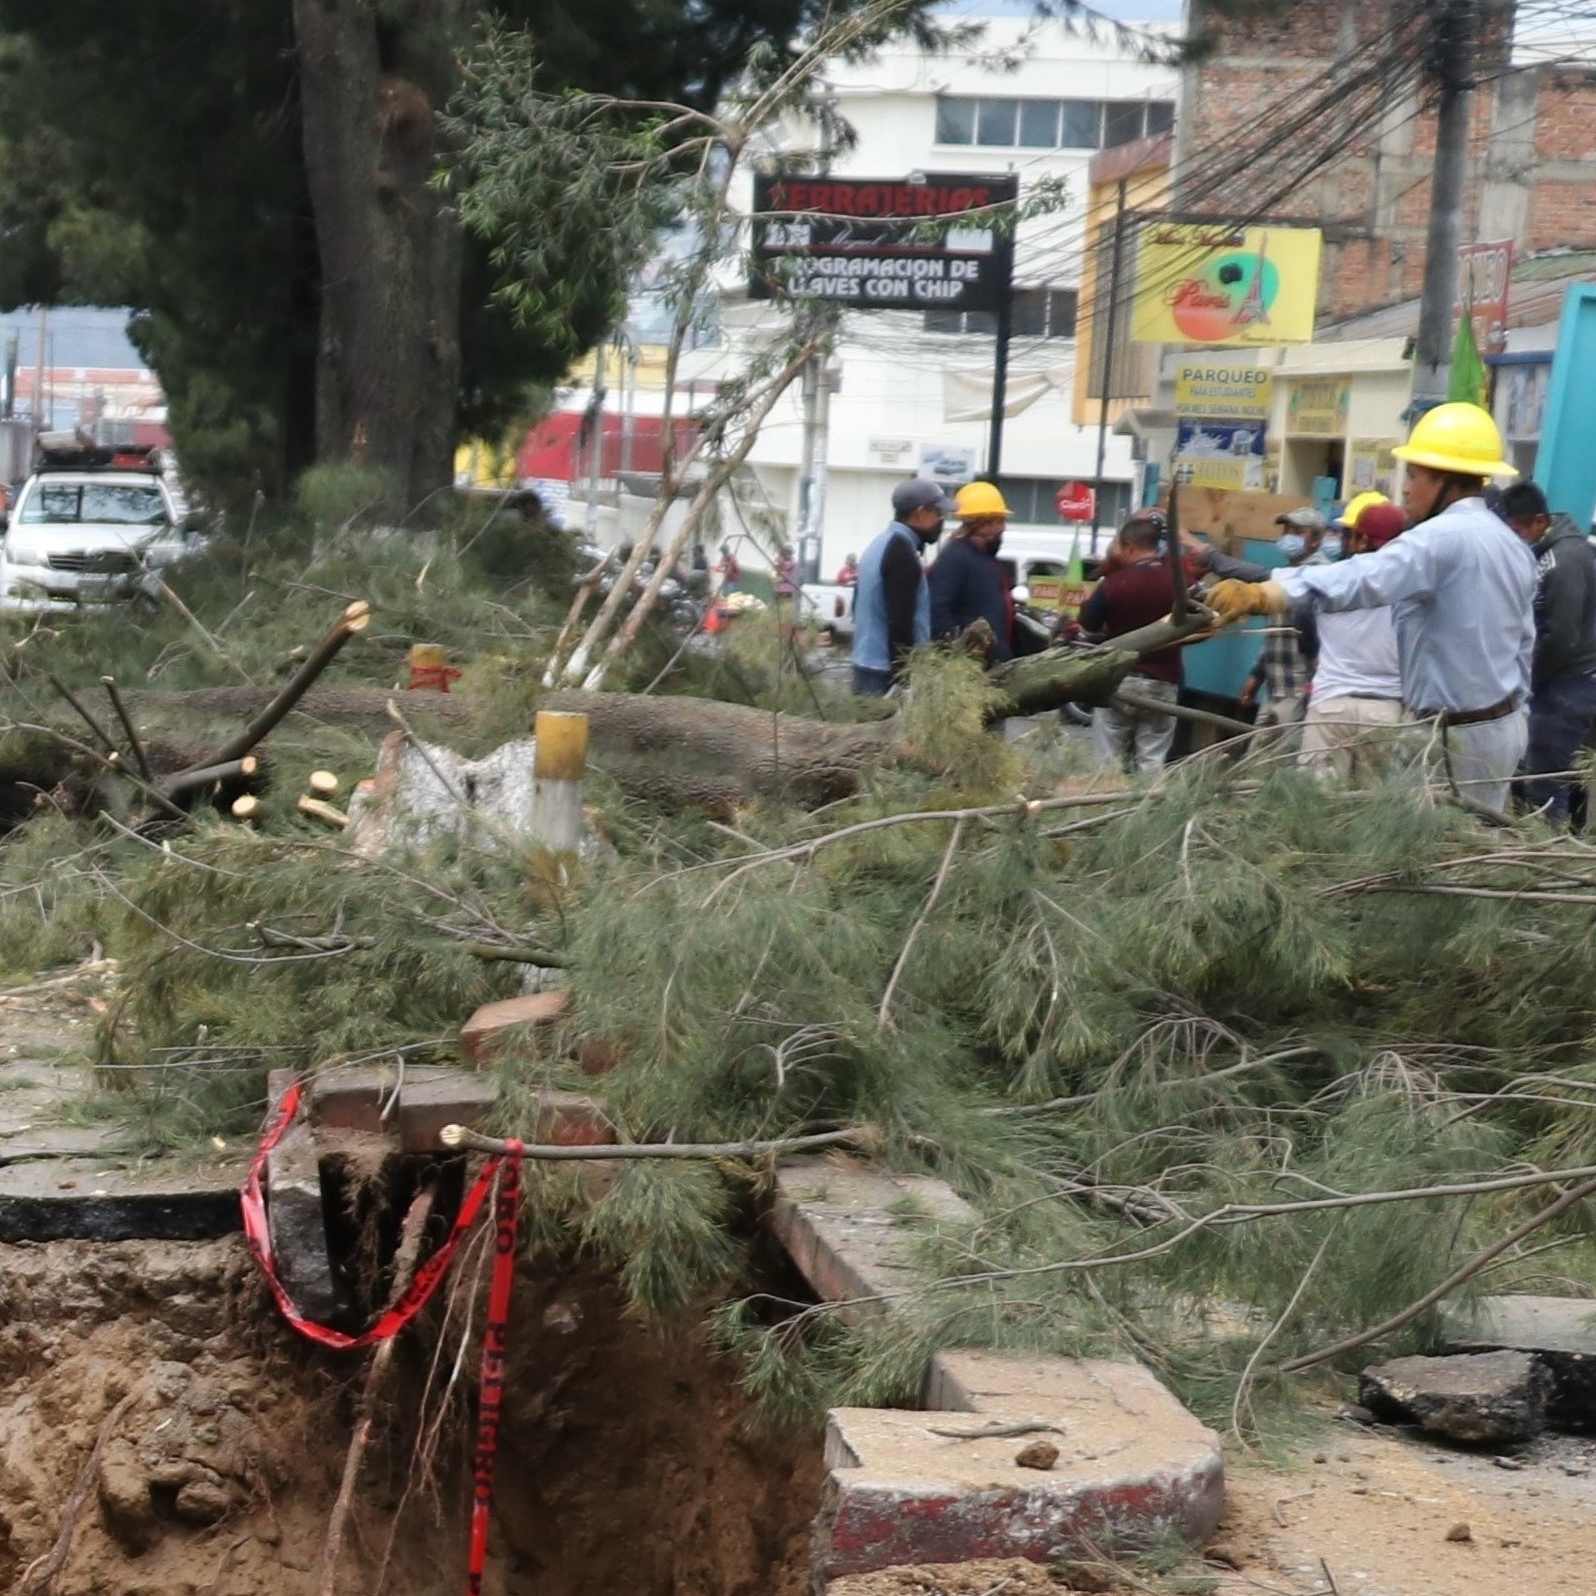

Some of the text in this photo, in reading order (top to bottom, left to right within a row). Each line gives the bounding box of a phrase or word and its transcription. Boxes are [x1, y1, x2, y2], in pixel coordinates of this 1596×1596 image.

[774, 256, 980, 279] OGRAMACION DE
[865, 278, 910, 297] CON
[915, 279, 965, 299] CHIP
[1182, 368, 1268, 385] PARQUEO
[473, 1321, 506, 1507] PELIGRO
